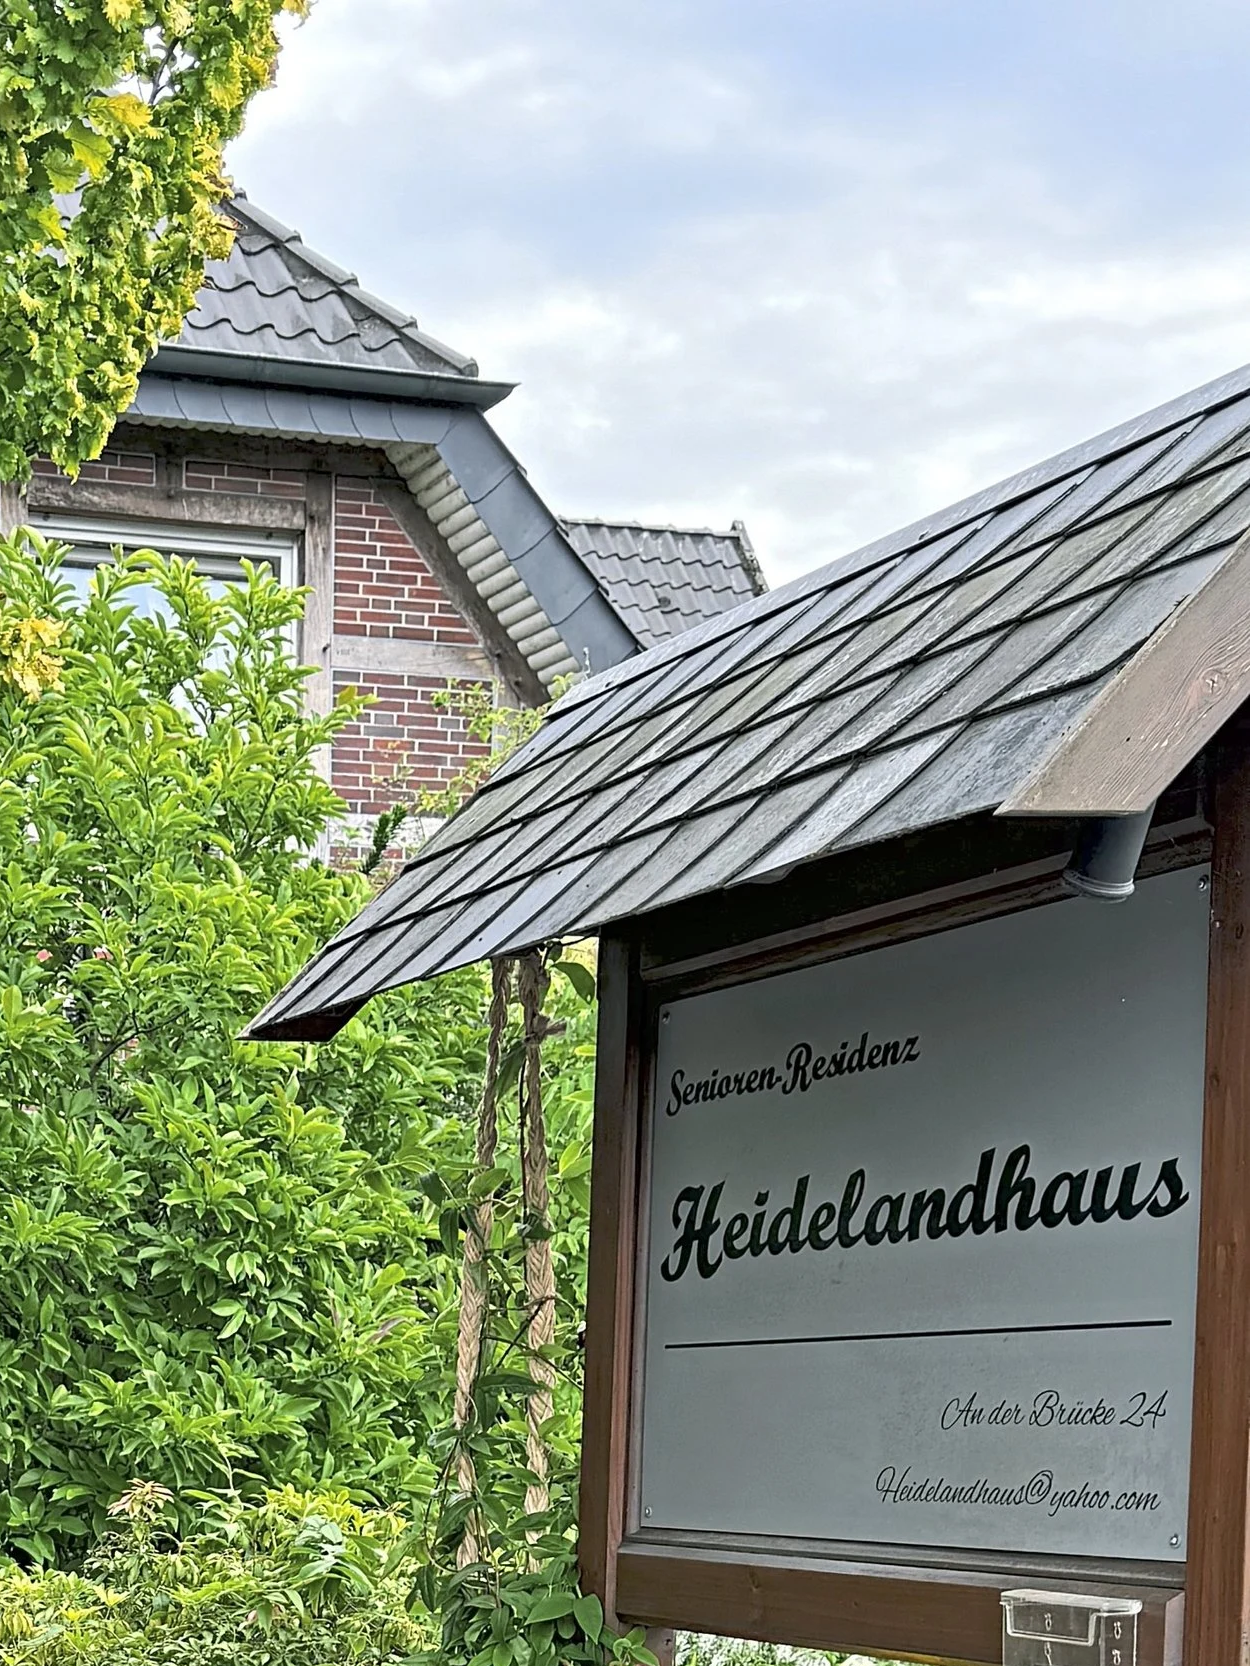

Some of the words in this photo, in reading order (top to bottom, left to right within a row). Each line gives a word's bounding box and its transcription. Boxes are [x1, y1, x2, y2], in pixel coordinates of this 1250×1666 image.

[665, 1031, 921, 1117] Senioren-Residenz
[659, 1143, 1190, 1283] Heidelandhaus
[940, 1391, 985, 1431] An
[987, 1399, 1026, 1426] der
[1028, 1389, 1116, 1427] Brücke
[1119, 1389, 1168, 1430] 24
[875, 1465, 1162, 1518] Heidelandhaus@yahoo.com
